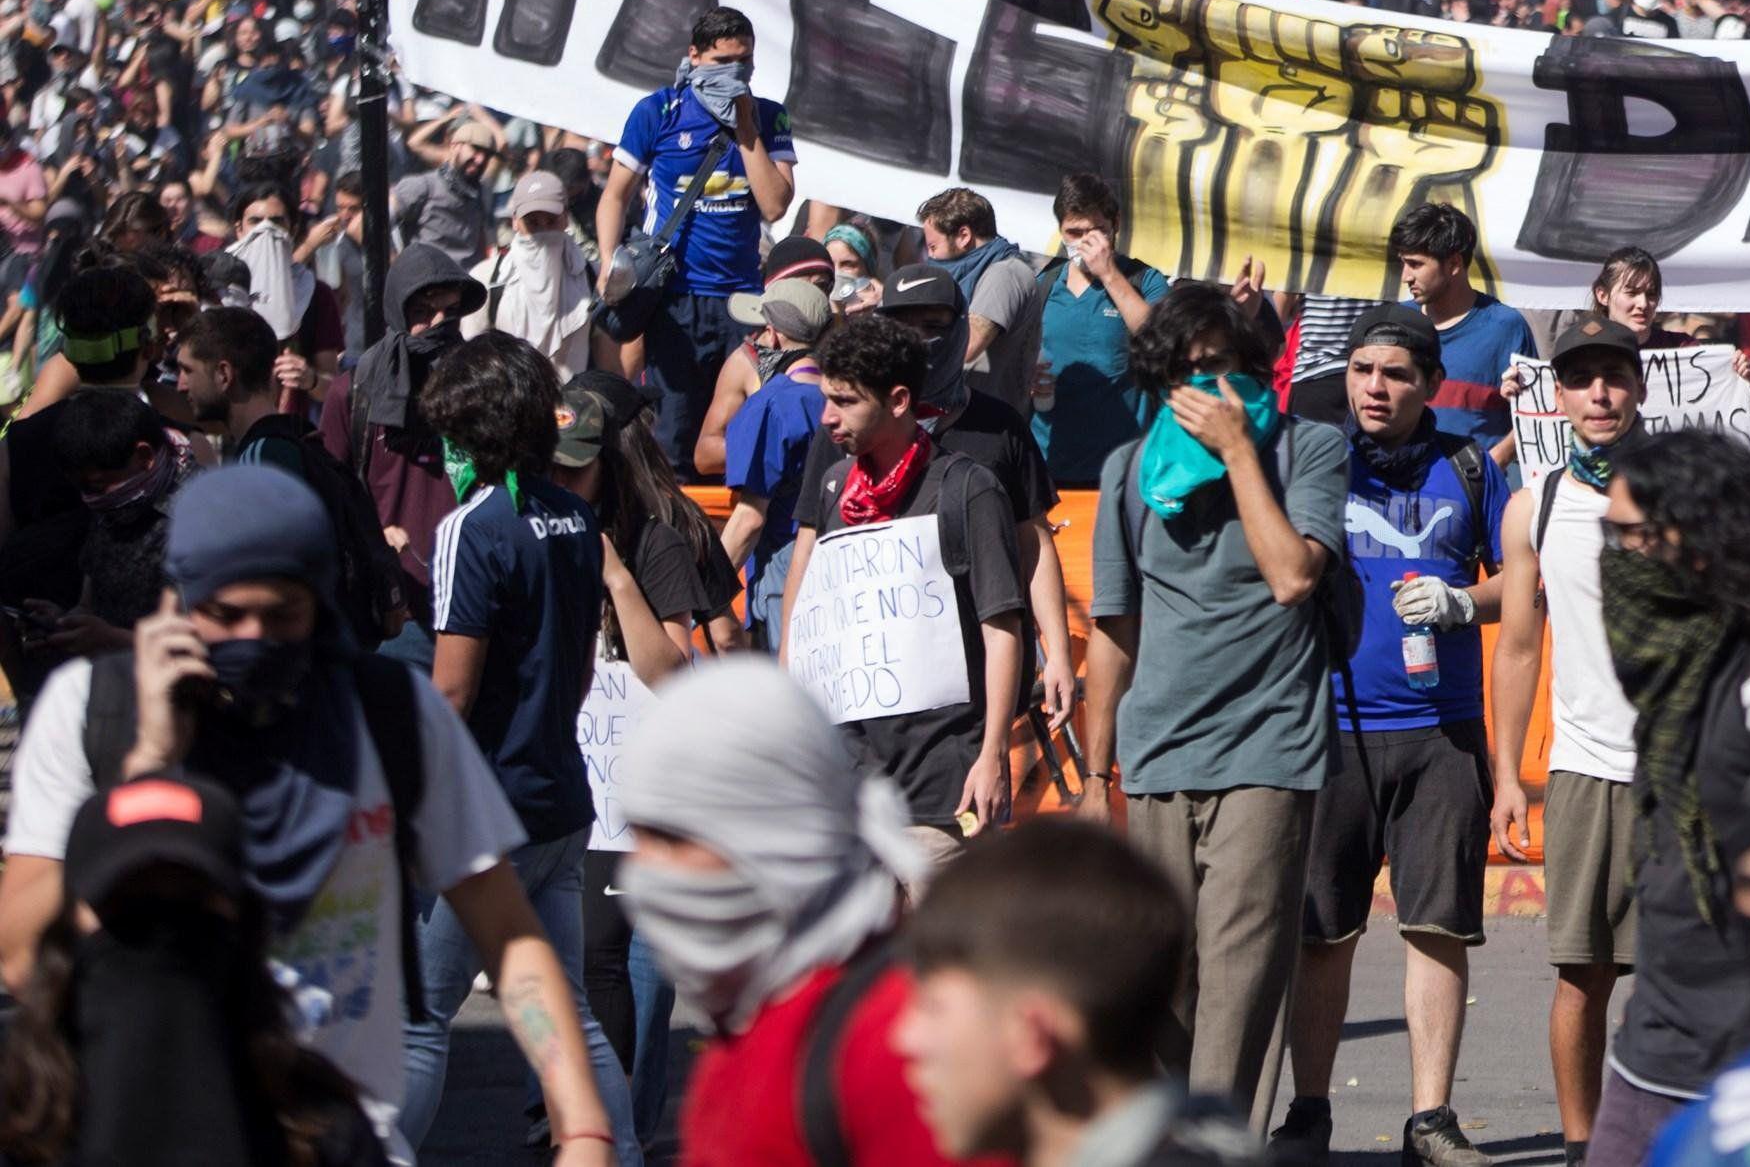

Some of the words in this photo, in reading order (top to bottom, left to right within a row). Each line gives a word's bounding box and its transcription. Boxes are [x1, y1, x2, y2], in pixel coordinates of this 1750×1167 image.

[674, 198, 748, 213] CVROLET
[1641, 350, 1711, 407] MIS
[834, 591, 868, 631] QUE
[878, 580, 944, 619] NOS
[862, 632, 901, 667] EL
[823, 667, 902, 714] MIEDO
